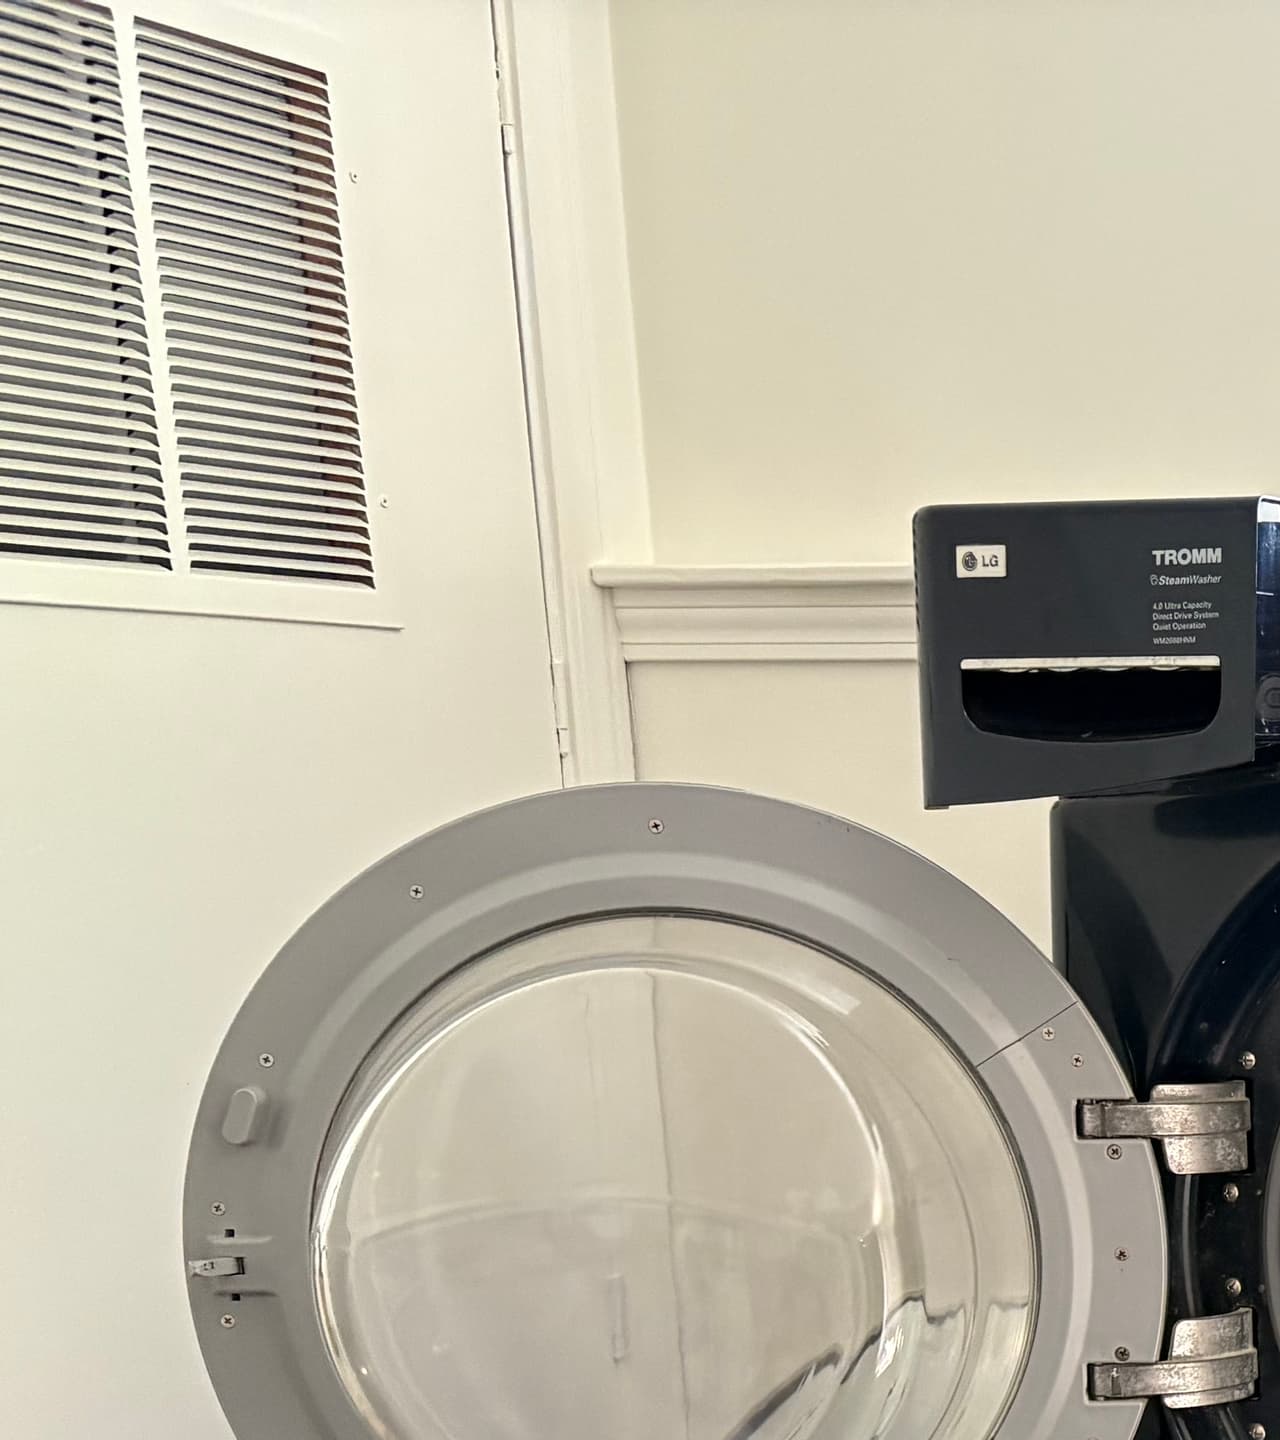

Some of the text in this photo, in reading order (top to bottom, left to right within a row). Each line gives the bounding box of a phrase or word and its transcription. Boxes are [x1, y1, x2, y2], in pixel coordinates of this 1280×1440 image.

[981, 554, 999, 567] LG
[1151, 547, 1222, 566] TROMM
[1158, 574, 1222, 586] SteamWasher
[1183, 600, 1212, 610] Capacity
[1152, 611, 1220, 621] Direct Drive System
[1152, 622, 1207, 632] Quiet Operation
